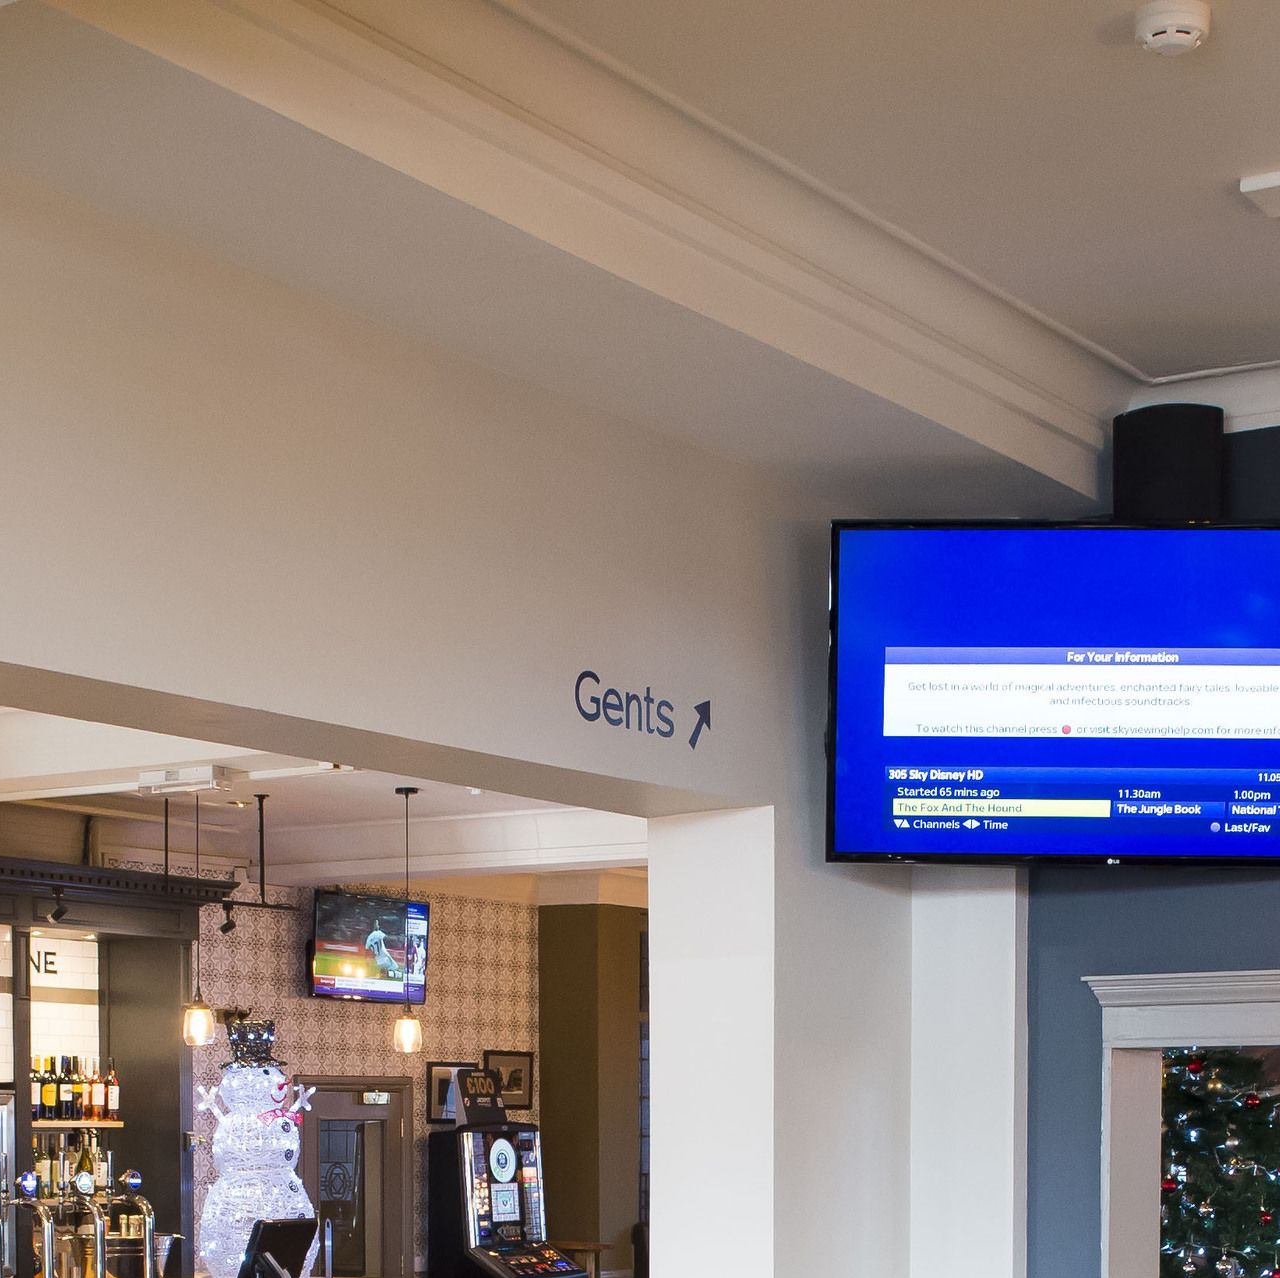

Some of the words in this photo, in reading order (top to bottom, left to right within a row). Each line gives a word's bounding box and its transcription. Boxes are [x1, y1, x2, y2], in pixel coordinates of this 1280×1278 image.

[1066, 651, 1085, 663] For
[1086, 651, 1113, 663] Your
[1114, 651, 1179, 663] Information
[908, 682, 927, 692] Get
[929, 682, 949, 692] lost
[970, 682, 999, 692] world
[1001, 682, 1014, 692] of
[1015, 682, 1054, 694] magical
[1120, 683, 1177, 693] enchanted
[1179, 683, 1202, 695] fairy
[1235, 684, 1279, 694] loveable
[575, 671, 674, 738] Gents
[1049, 697, 1070, 707] and
[1072, 697, 1123, 707] infectious
[916, 724, 930, 734] To
[932, 724, 962, 734] watch
[965, 724, 984, 734] this
[986, 724, 1027, 735] channel
[1029, 726, 1057, 737] press
[1090, 725, 1110, 735] visit
[1216, 726, 1231, 735] for
[1233, 727, 1262, 736] more
[888, 769, 907, 780] 305
[909, 769, 928, 782] Sky
[930, 769, 965, 782] Disney
[967, 770, 984, 780] HD
[897, 787, 937, 797] Started
[939, 787, 952, 797] 65
[953, 787, 978, 797] mins
[980, 789, 1000, 799] ago
[1118, 789, 1161, 799] 11.30am
[1233, 790, 1271, 802] 1.00pm
[897, 803, 918, 812] The
[920, 803, 939, 813] Fox
[941, 803, 963, 813] And
[964, 803, 985, 813] The
[987, 803, 1022, 814] Hound
[1117, 804, 1138, 814] The
[1138, 804, 1173, 816] Jungle
[1174, 804, 1201, 815] Book
[1231, 805, 1276, 816] National
[913, 819, 960, 829] Channels
[983, 820, 1008, 830] Time
[1224, 823, 1271, 833] Last/Fav
